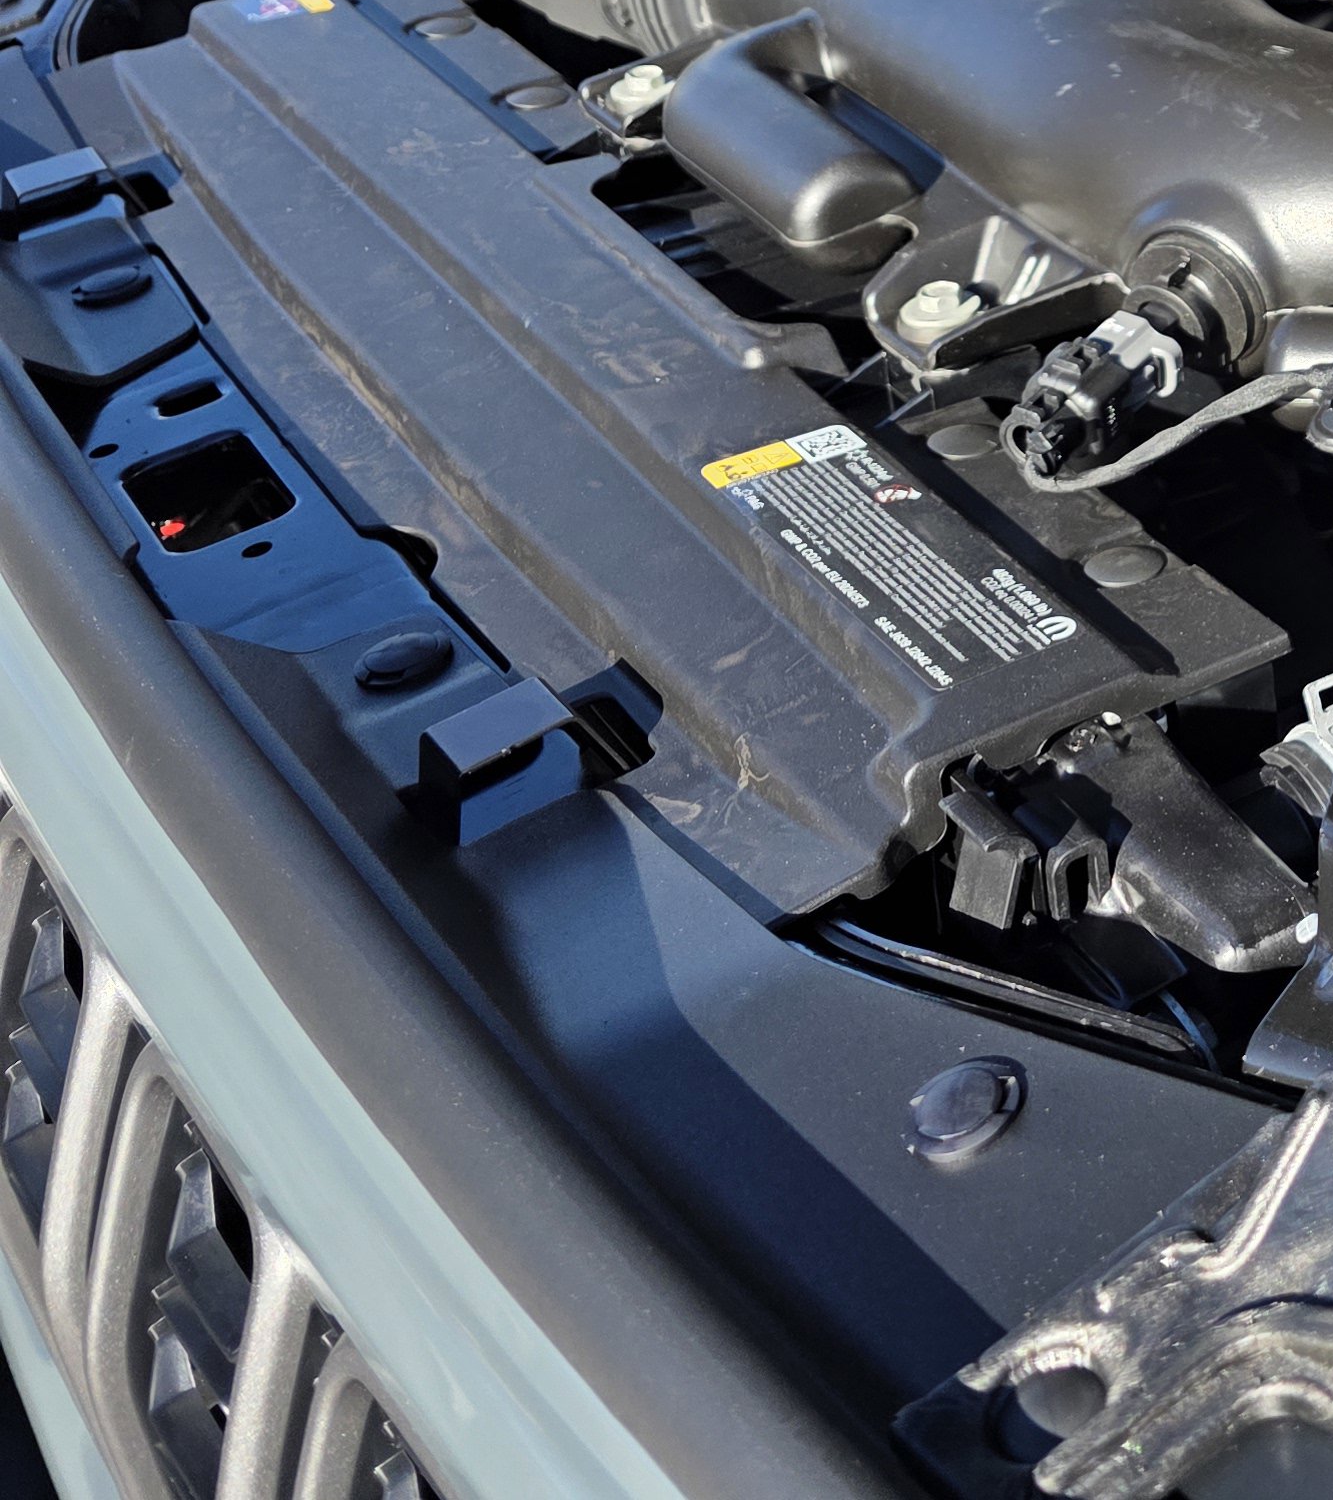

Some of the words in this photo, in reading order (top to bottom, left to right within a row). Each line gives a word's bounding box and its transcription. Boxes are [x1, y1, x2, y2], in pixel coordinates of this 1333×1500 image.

[800, 547, 821, 564] CO2
[825, 570, 842, 583] EU
[873, 615, 896, 633] SAE
